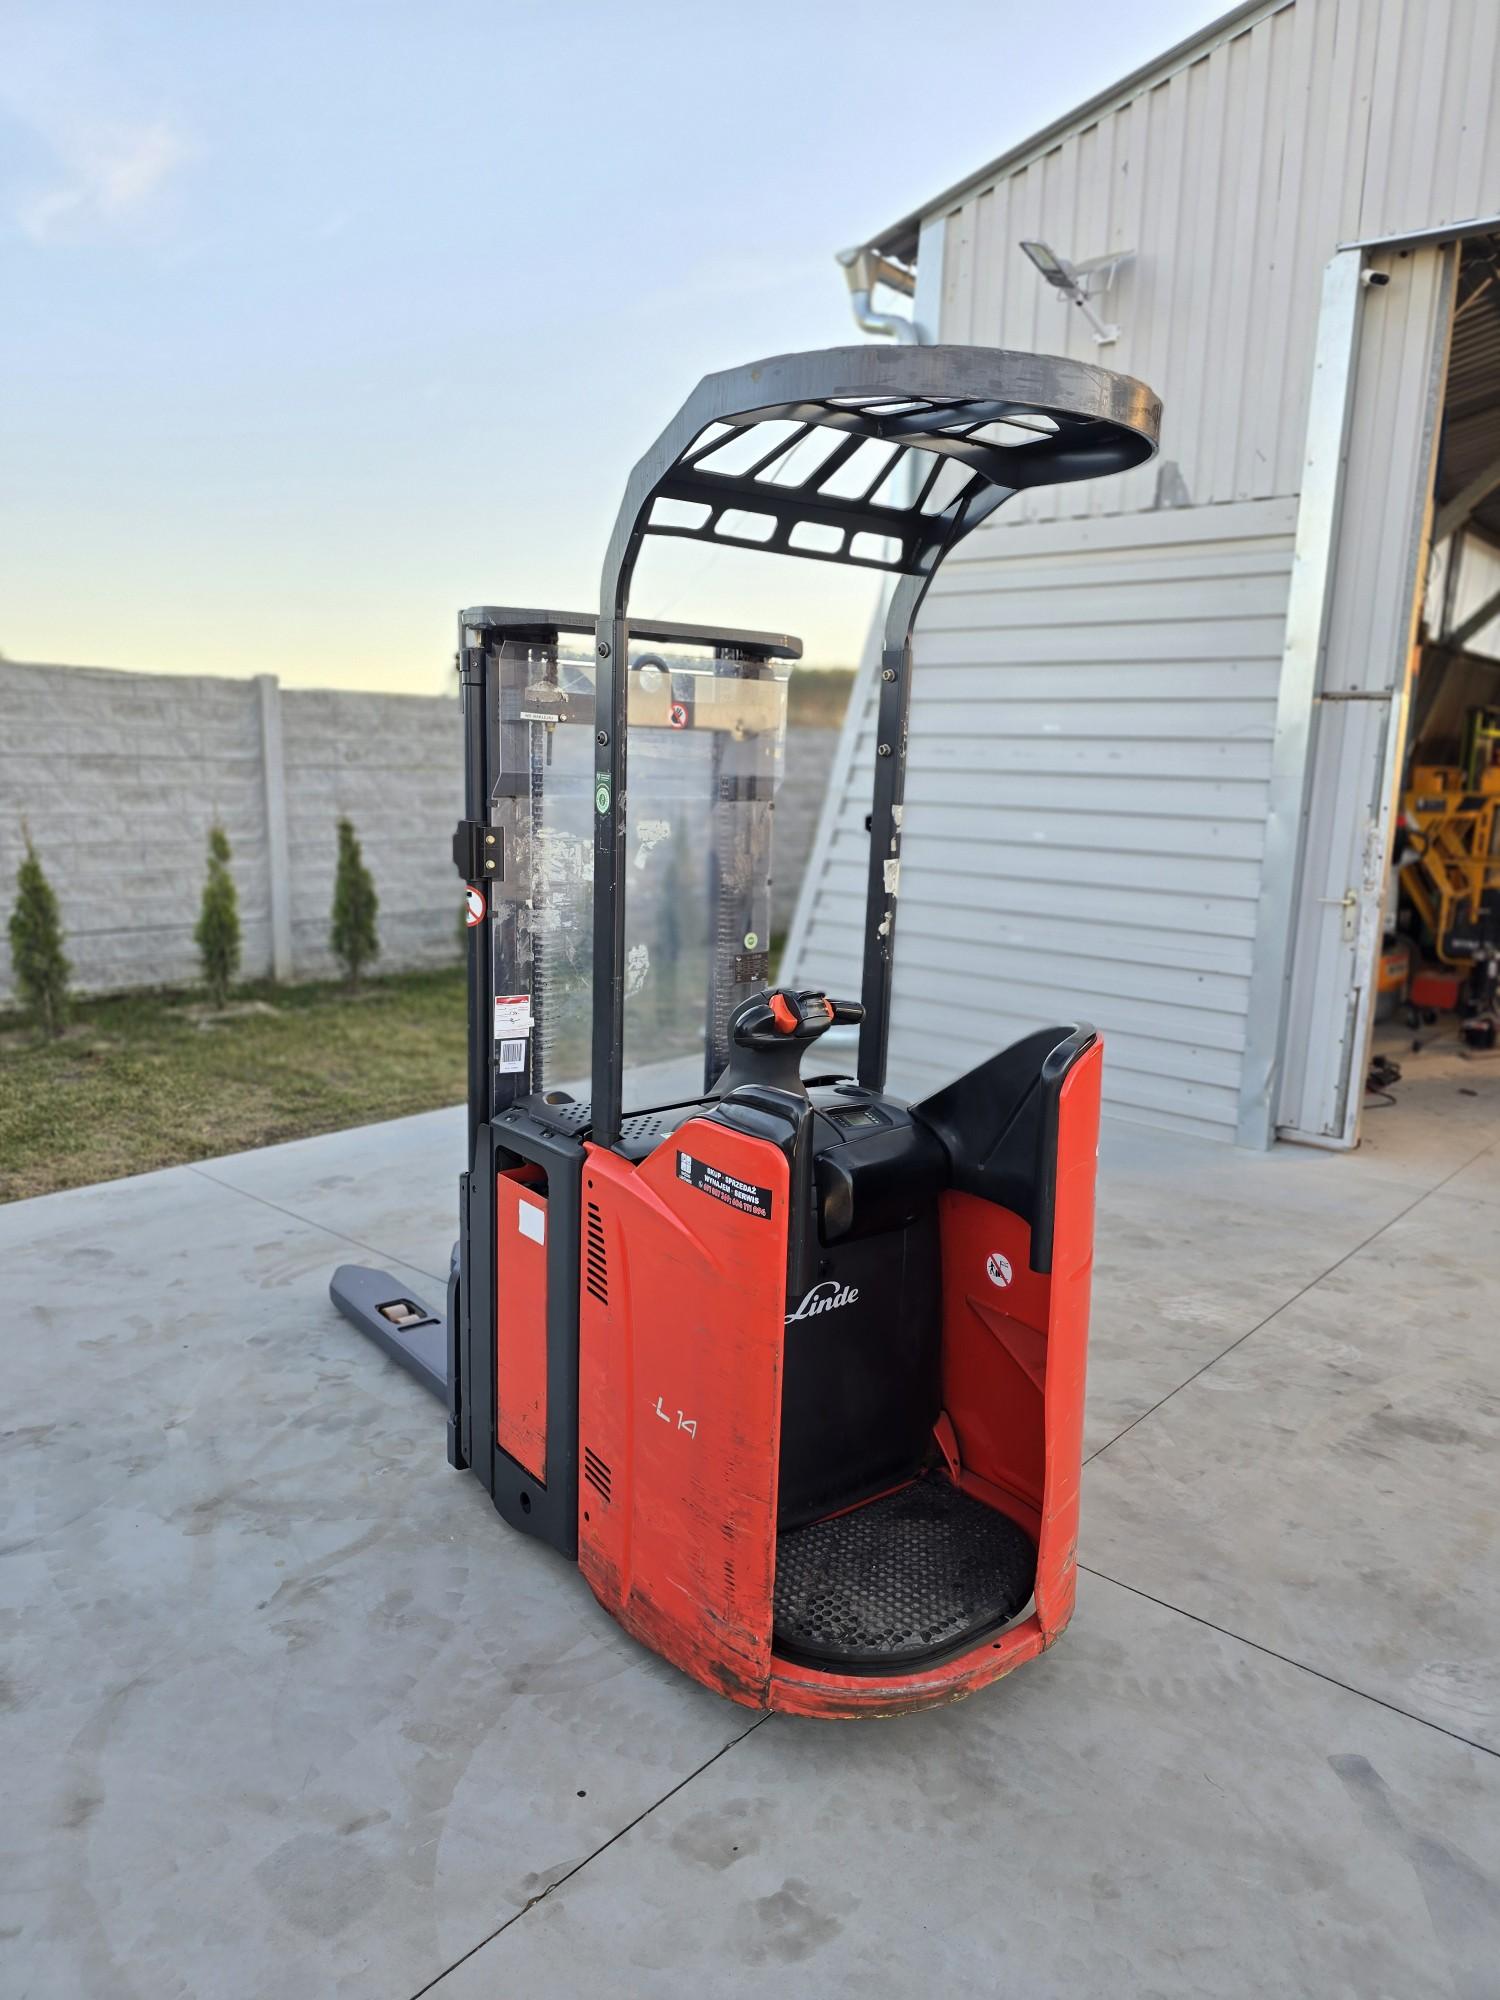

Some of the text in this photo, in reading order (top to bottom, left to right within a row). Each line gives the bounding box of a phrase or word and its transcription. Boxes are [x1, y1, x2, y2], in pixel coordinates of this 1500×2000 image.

[704, 1174, 731, 1194] WYNAJEM
[734, 1189, 760, 1204] SERWIS
[783, 1281, 859, 1325] Linde
